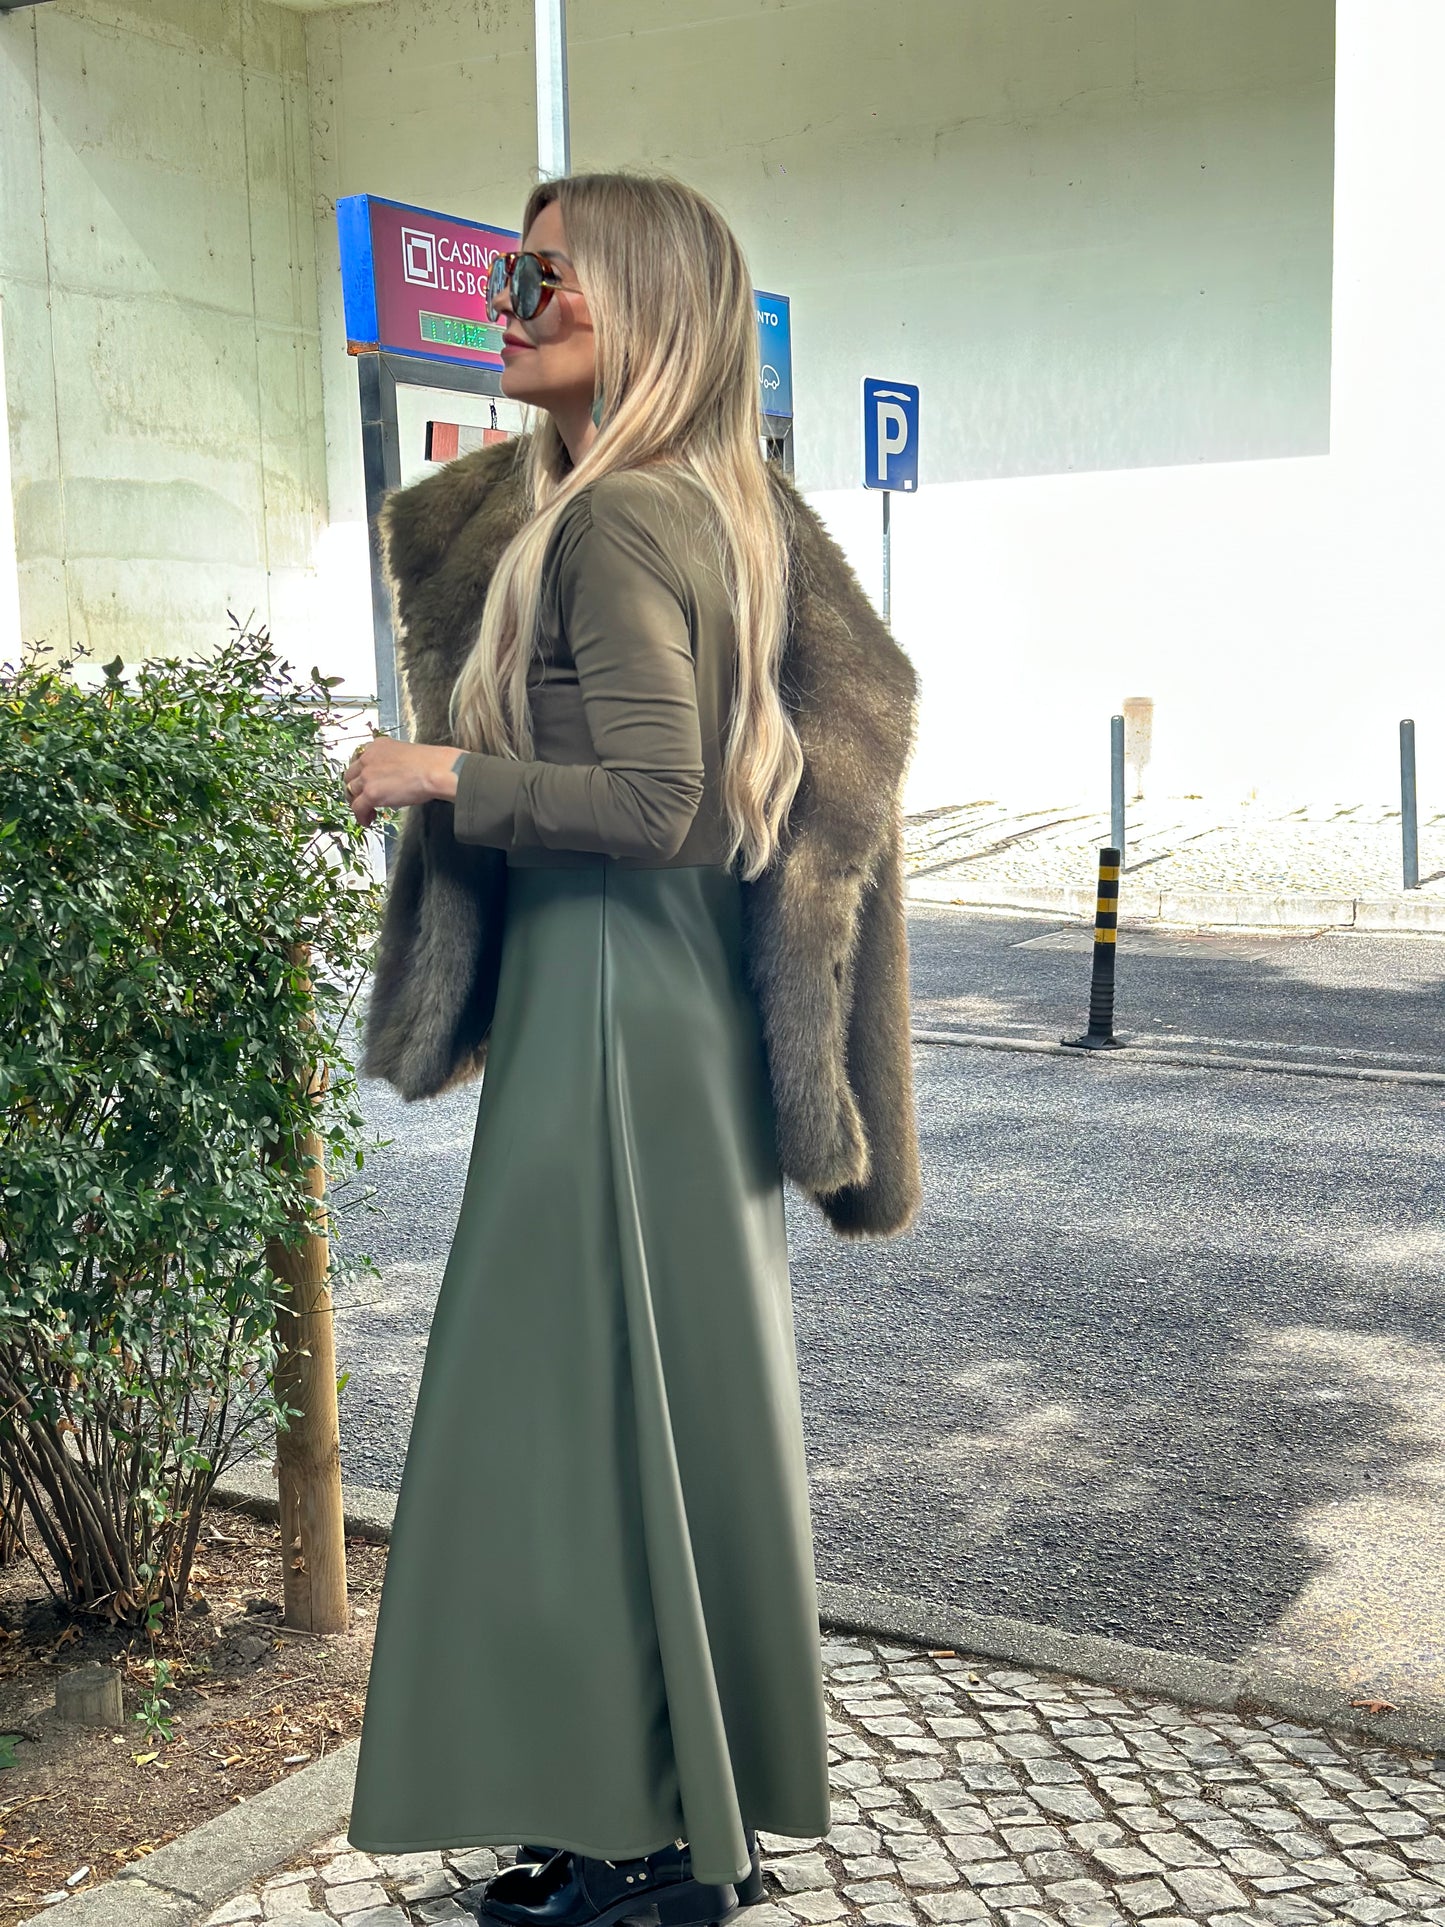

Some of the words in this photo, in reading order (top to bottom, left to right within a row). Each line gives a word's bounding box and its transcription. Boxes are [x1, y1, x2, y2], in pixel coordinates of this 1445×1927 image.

[440, 266, 488, 298] LISBO
[757, 310, 779, 327] NTO
[877, 401, 908, 481] P
